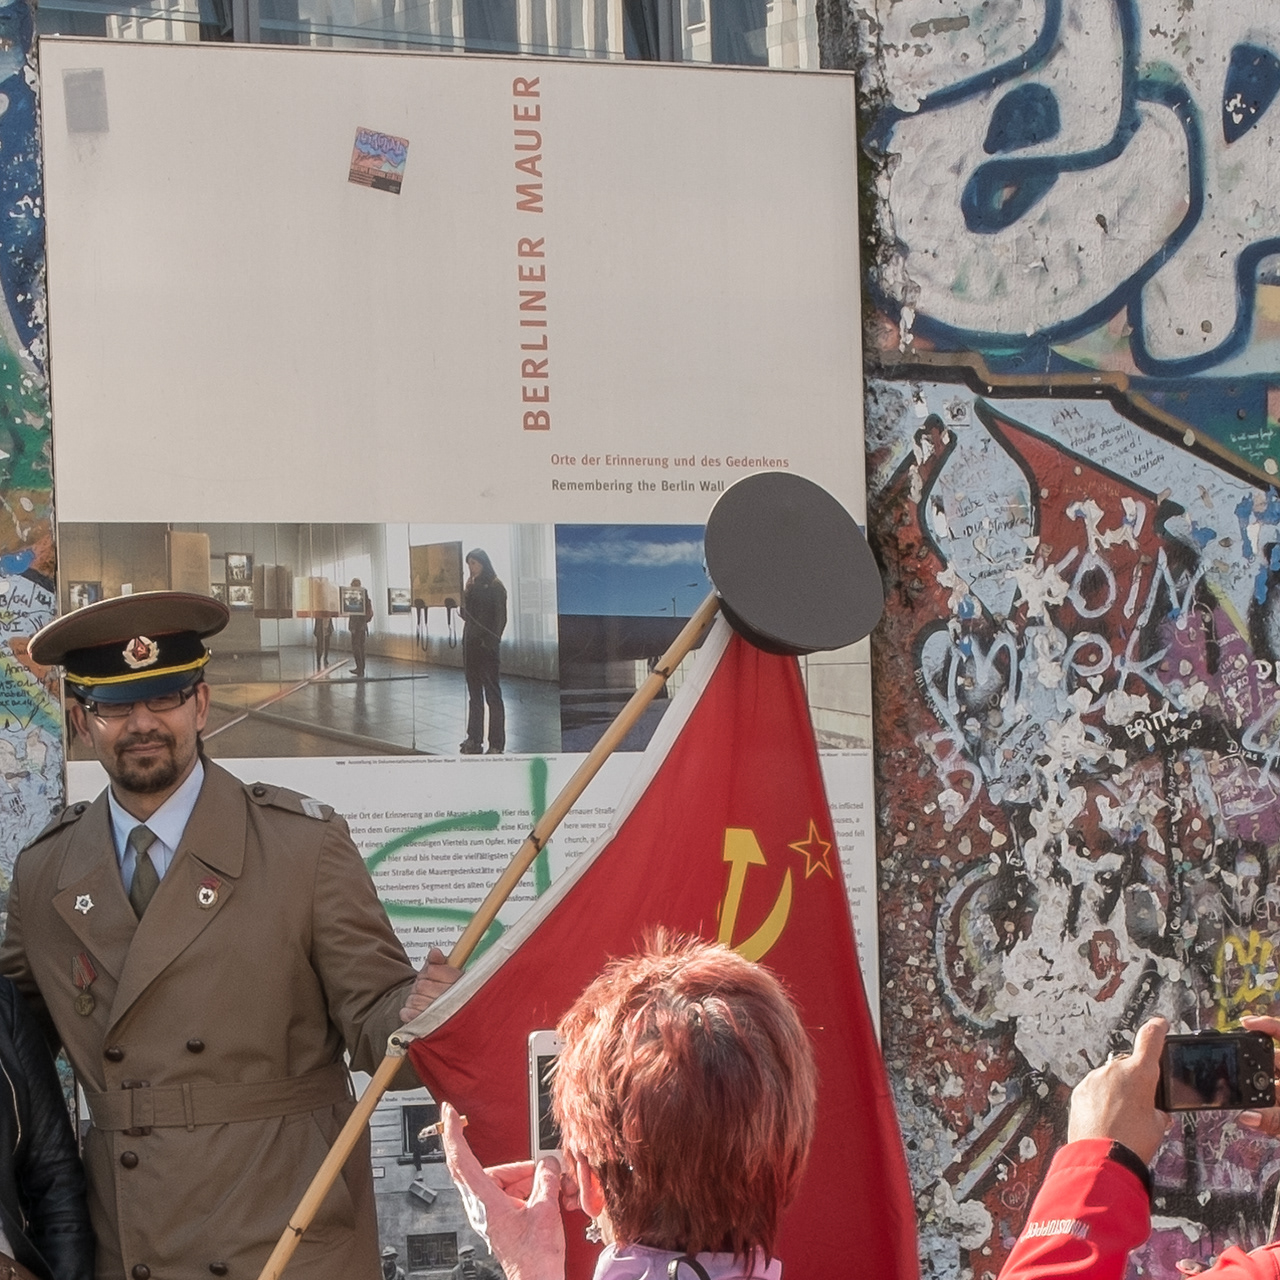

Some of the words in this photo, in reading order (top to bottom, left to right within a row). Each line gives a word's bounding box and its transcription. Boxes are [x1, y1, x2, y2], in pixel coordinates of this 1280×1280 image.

[513, 77, 543, 212] MAUER
[518, 238, 549, 430] BERLINER
[551, 454, 575, 467] Orte
[581, 454, 601, 467] der
[605, 454, 669, 471] Erinnerung
[674, 454, 696, 467] und
[700, 454, 720, 468] des
[726, 455, 788, 469] Gedenkens
[551, 479, 632, 494] Remembering
[637, 479, 656, 492] the
[661, 479, 695, 493] Berlin
[698, 480, 724, 493] Wall
